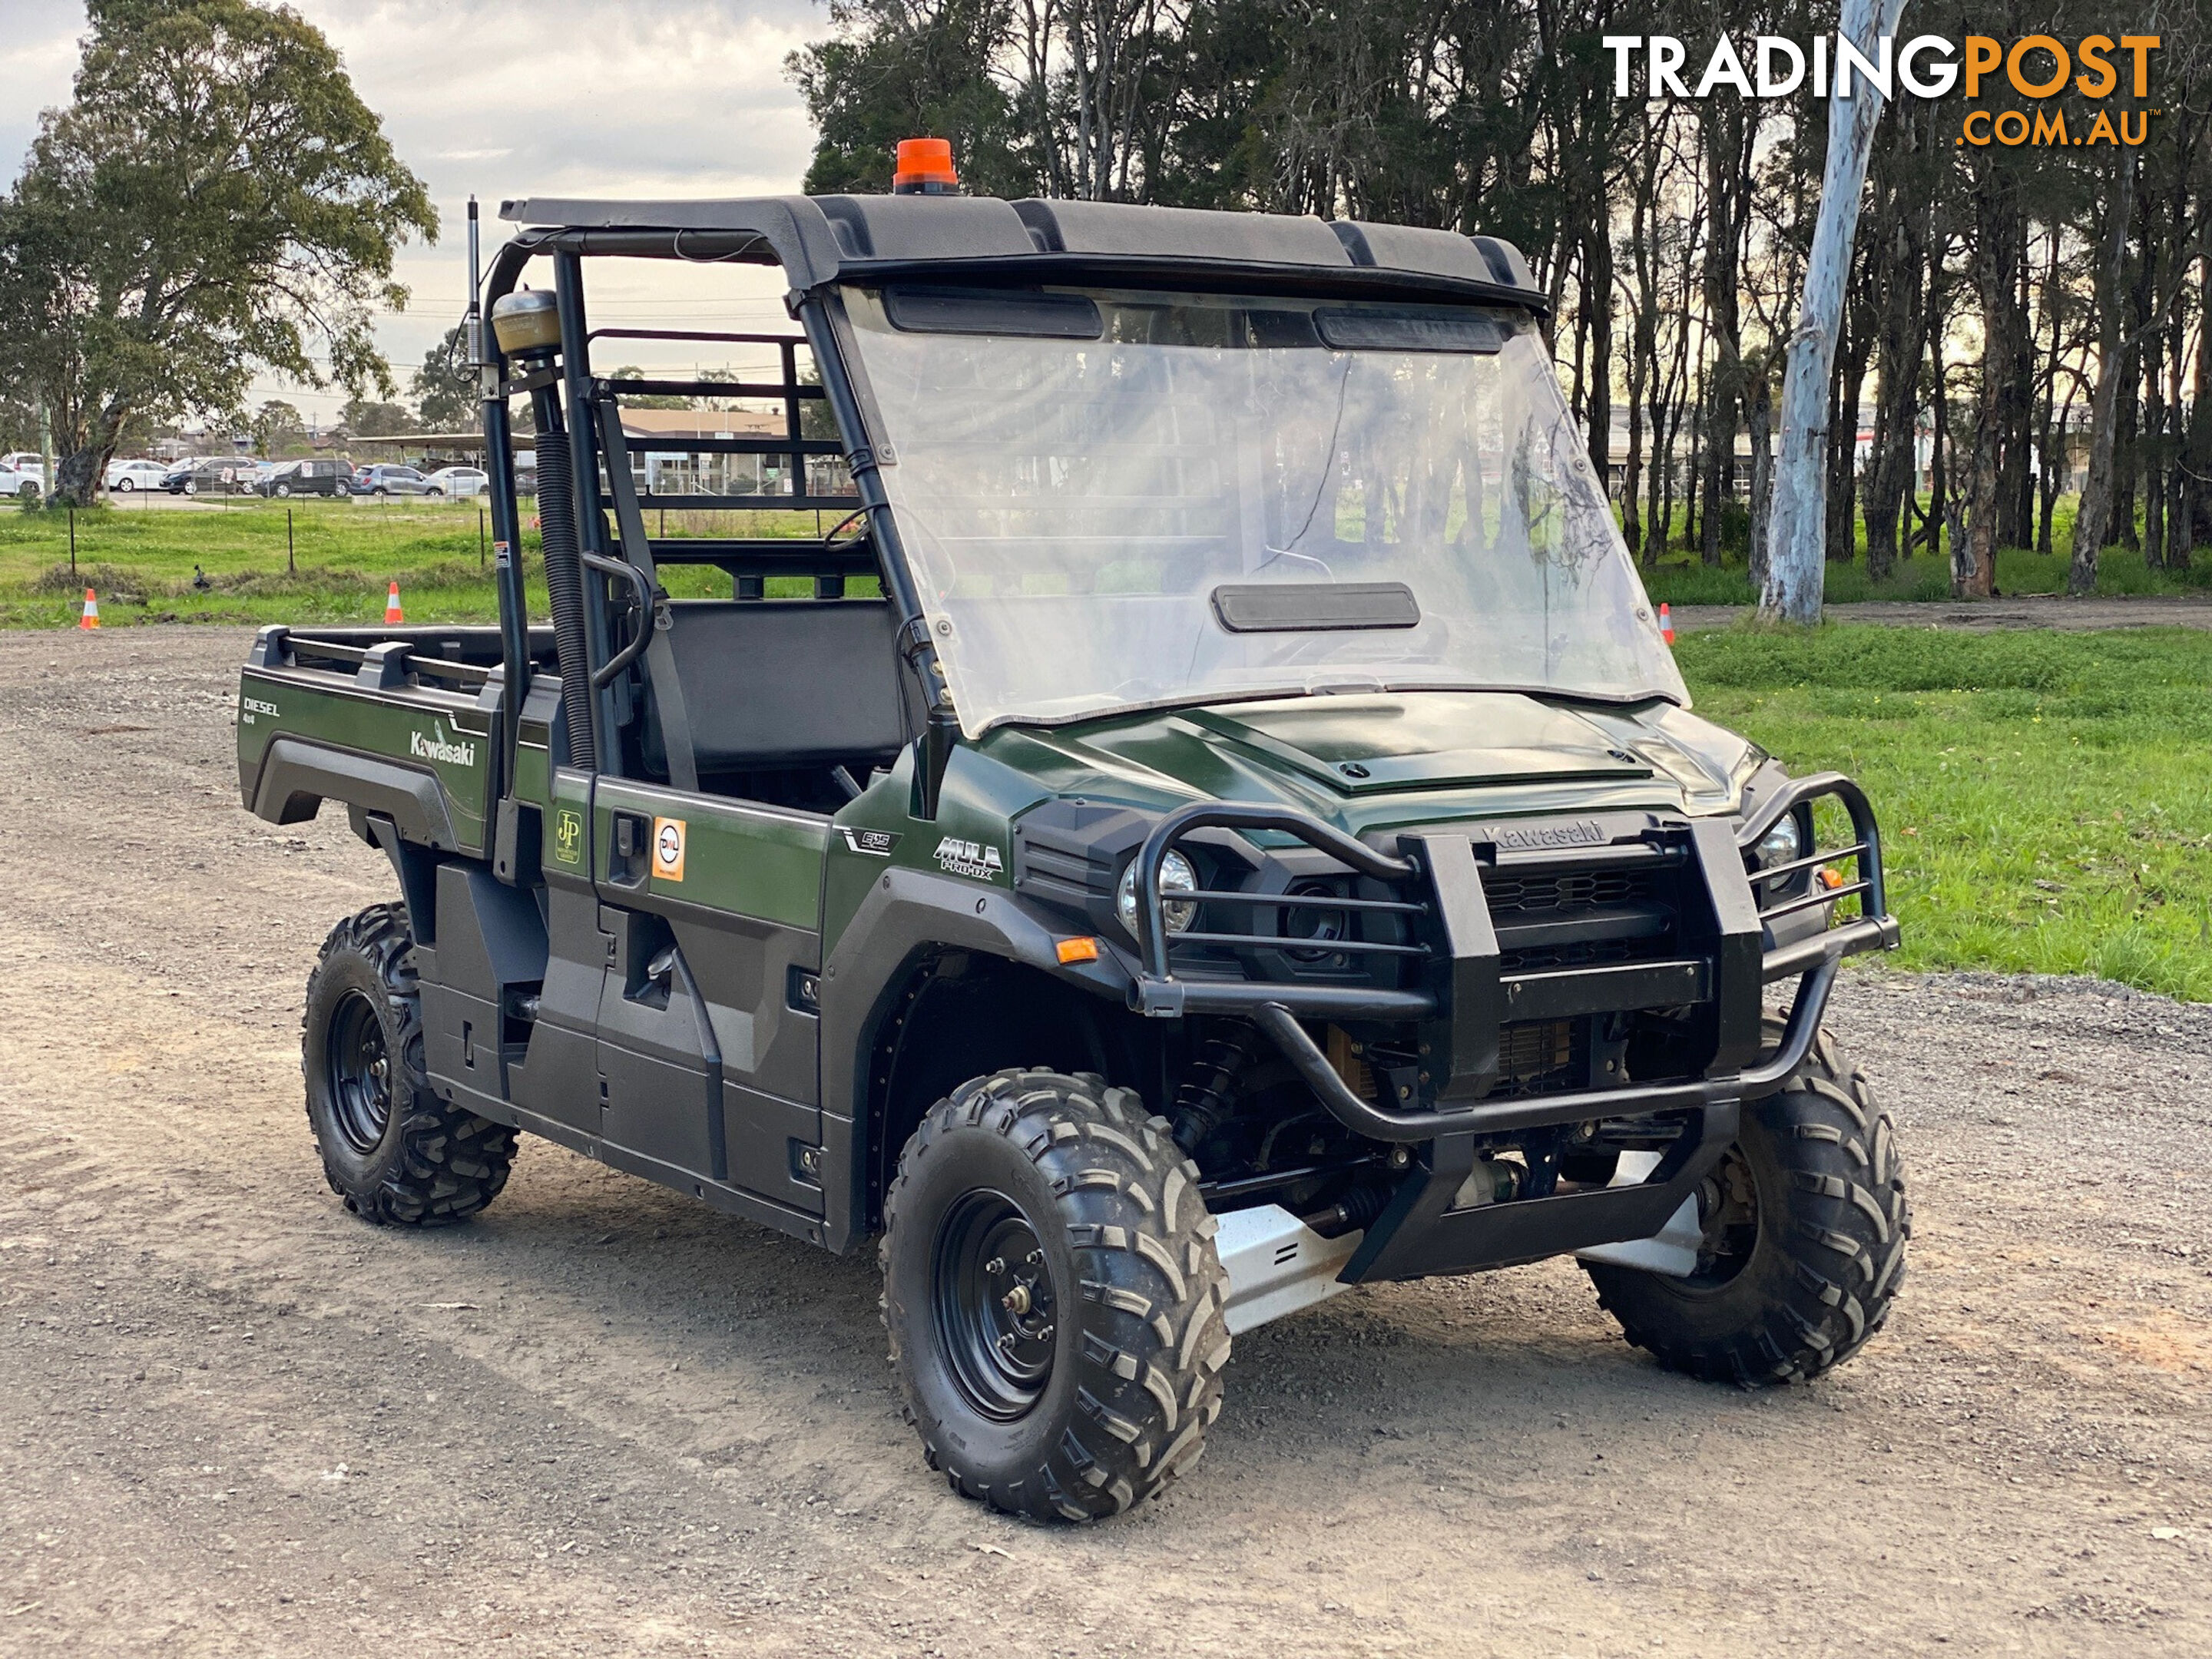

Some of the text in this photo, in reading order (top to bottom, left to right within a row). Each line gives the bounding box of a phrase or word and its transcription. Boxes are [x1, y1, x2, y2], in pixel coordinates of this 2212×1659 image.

[243, 697, 280, 717] DIESEL
[410, 731, 475, 767] Kawasaki
[1482, 820, 1606, 849] Kawasaki
[933, 836, 1004, 872] MULE
